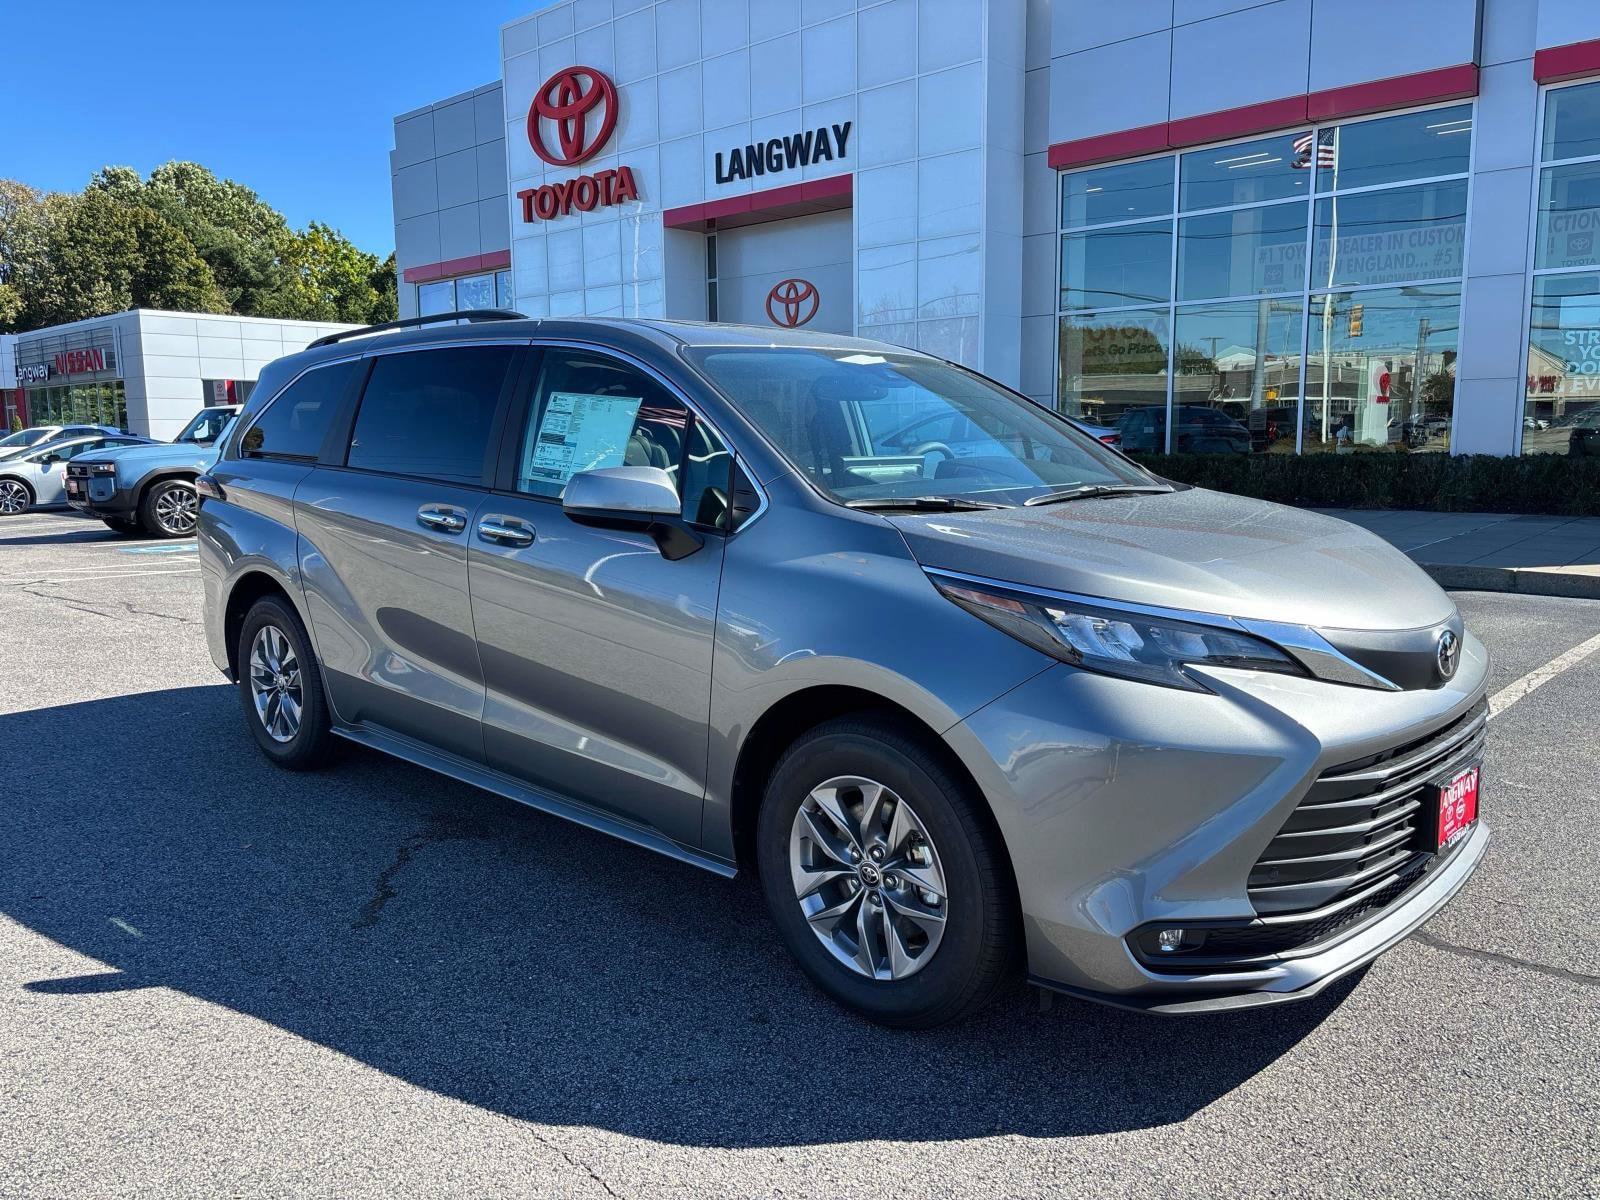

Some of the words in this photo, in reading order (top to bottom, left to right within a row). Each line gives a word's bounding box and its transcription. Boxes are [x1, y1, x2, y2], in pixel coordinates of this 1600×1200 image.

[715, 121, 851, 184] LANGWAY
[517, 166, 637, 222] TOYOTA
[1258, 247, 1273, 264] #1
[1387, 233, 1404, 251] IN
[1433, 247, 1453, 266] #5
[1560, 257, 1596, 267] TOYOTA
[55, 347, 106, 374] NISSAN
[1108, 344, 1125, 355] Go
[15, 363, 50, 382] Langway
